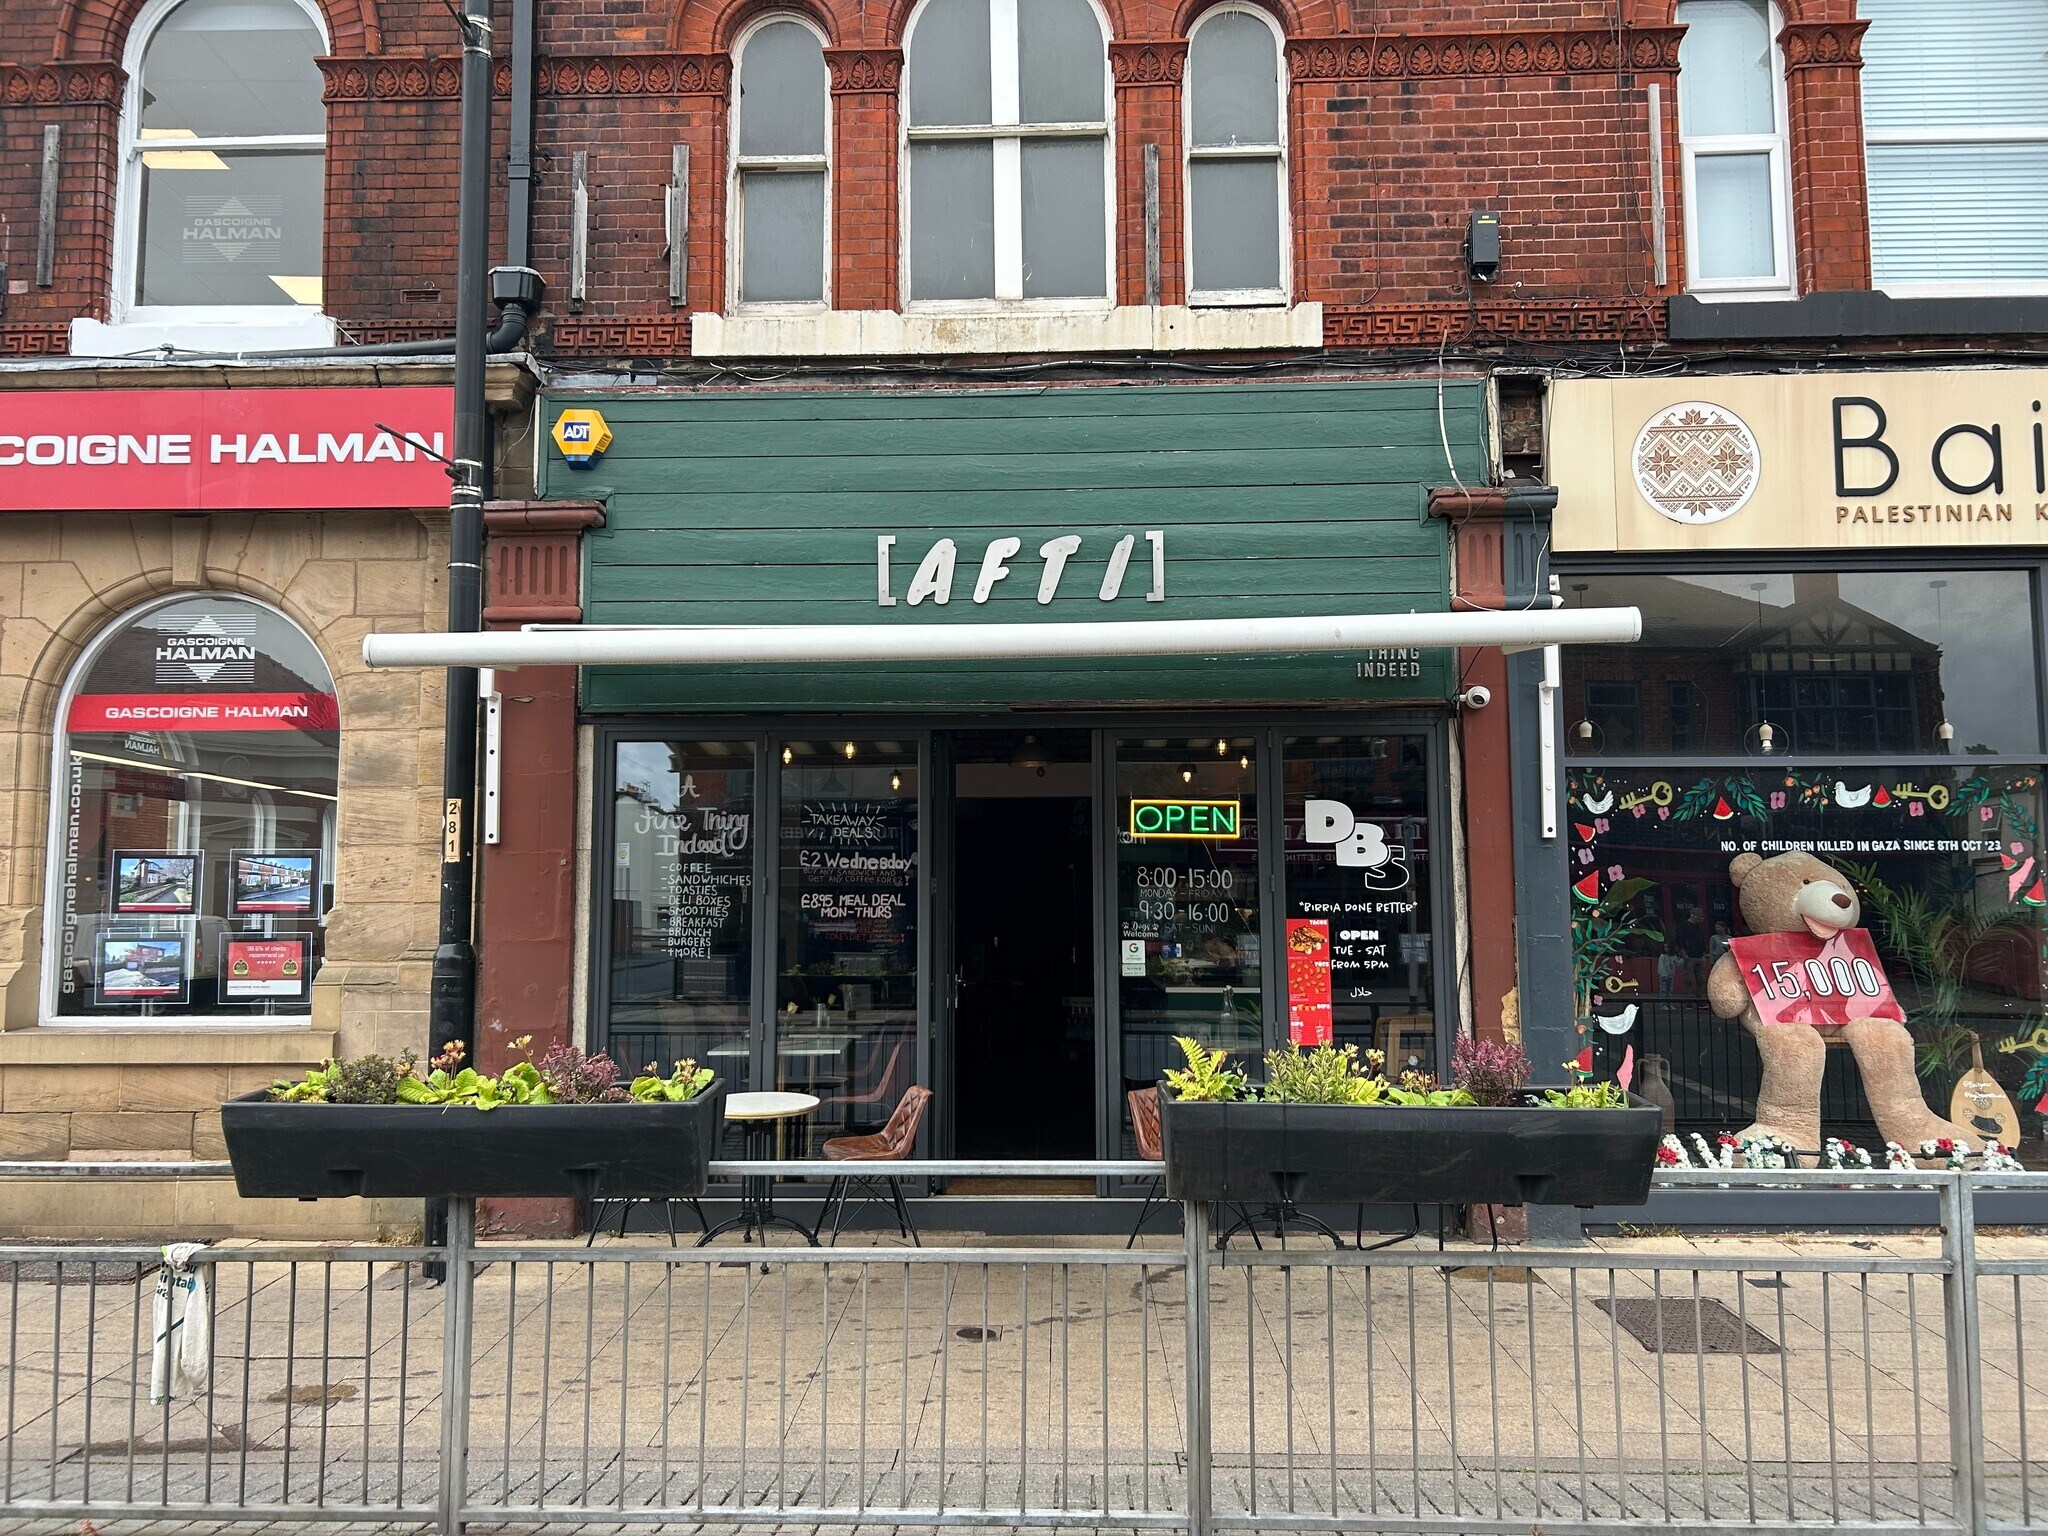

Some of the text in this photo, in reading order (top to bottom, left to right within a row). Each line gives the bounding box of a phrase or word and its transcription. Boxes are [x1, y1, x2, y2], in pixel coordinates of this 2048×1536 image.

[194, 218, 272, 226] GASCOIGNE
[183, 227, 282, 240] HALMAN
[564, 424, 590, 439] ADT
[210, 431, 444, 464] HALMAN
[1835, 503, 2013, 524] PALESTINIAN
[167, 637, 245, 646] GASCOIGNE
[155, 646, 256, 661] HALMAN
[1356, 662, 1420, 678] INDEED
[105, 706, 308, 719] GASCOIGNE HALMAN
[677, 774, 700, 798] A
[810, 814, 875, 826] TAKEAWAY
[1136, 805, 1234, 832] OPEN
[834, 827, 873, 838] DEALS
[1721, 840, 2001, 852] NO. OF CHILDREN KILLED IN GAZA SINCE 8TH OCT '23
[800, 850, 912, 872] £2 Wednesday
[62, 755, 83, 995] gascoignehalman.co.uk
[837, 869, 877, 877] SANDWICH
[839, 894, 869, 906] MEAL
[872, 893, 906, 906] DEAL
[1140, 889, 1177, 898] MONDAY
[1189, 889, 1225, 898] FRIDAY
[696, 896, 731, 908] BOXES
[1299, 901, 1418, 913] "BIRRIA DONE BETTER"
[821, 906, 893, 919] MON-THURS
[1132, 921, 1150, 932] Dogs
[1123, 930, 1159, 938] Welcome
[1340, 930, 1379, 940] OPEN
[1333, 945, 1353, 955] TUE
[1365, 944, 1387, 956] SAT
[1331, 959, 1389, 970] FROM 5PM
[1752, 957, 1881, 1002] 15,000
[1350, 986, 1373, 998] حلال
